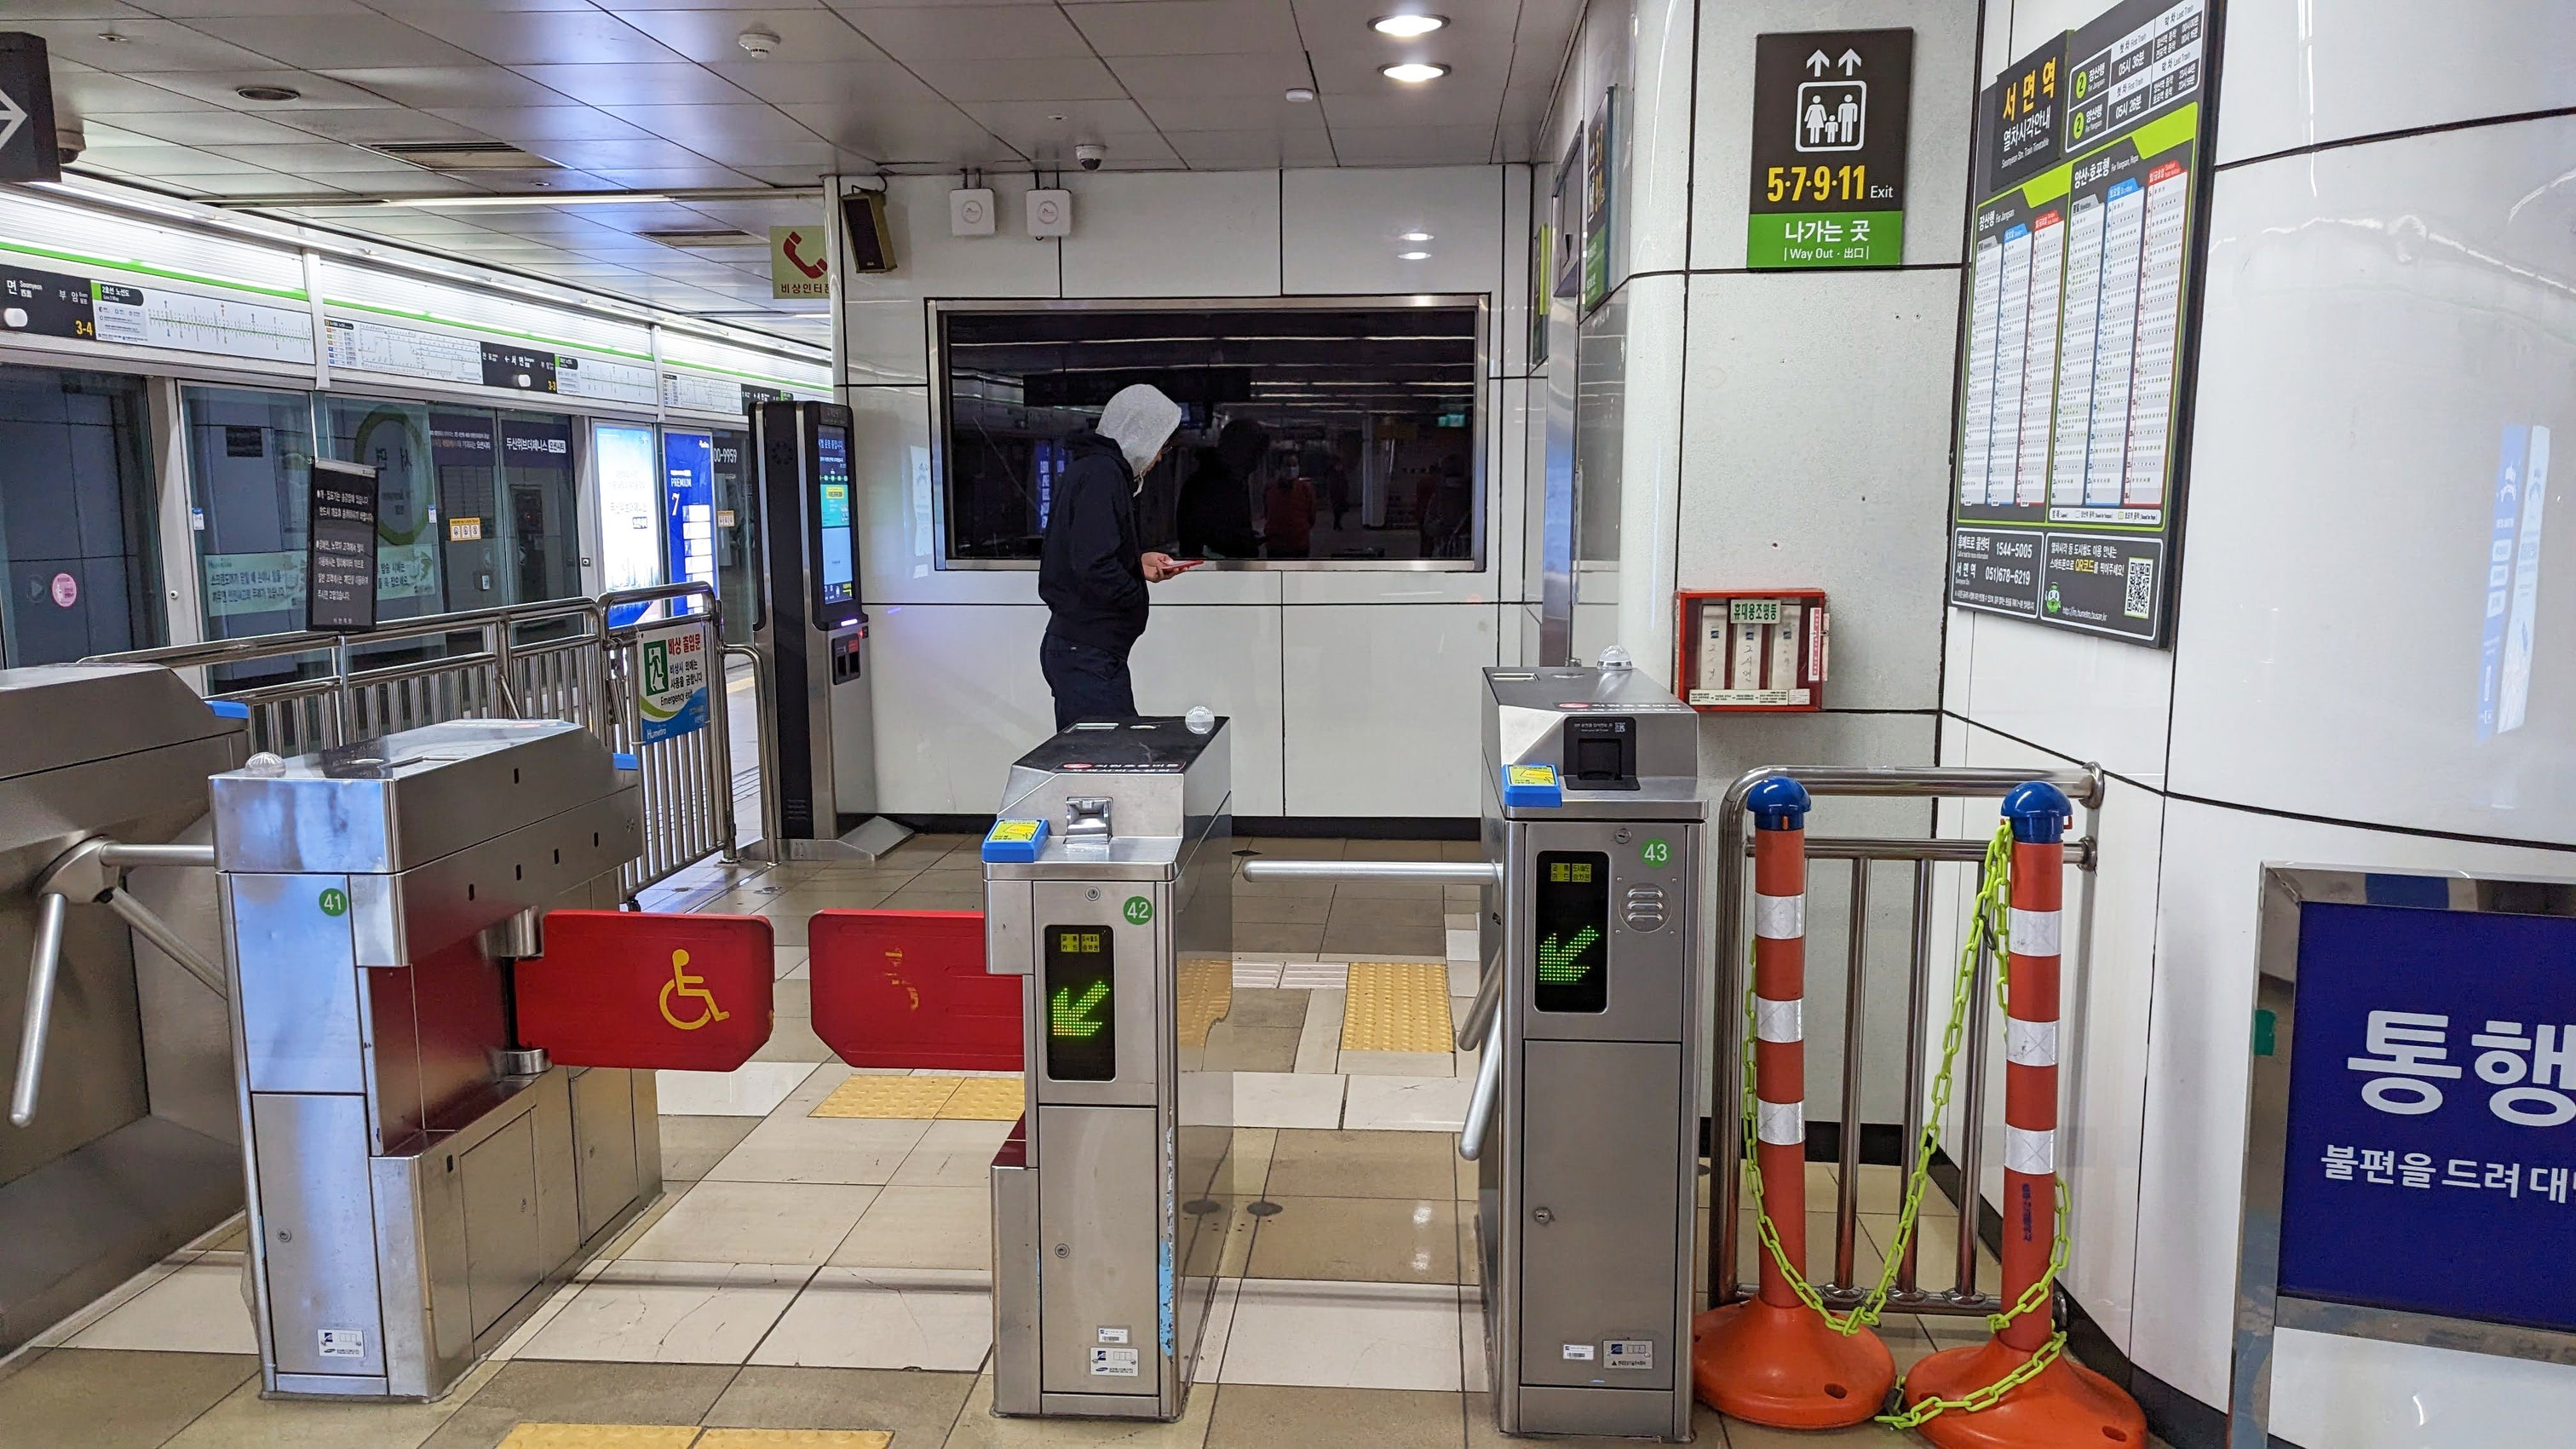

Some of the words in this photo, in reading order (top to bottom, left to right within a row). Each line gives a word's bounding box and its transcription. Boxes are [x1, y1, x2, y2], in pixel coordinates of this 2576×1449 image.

[2004, 105, 2051, 152] 열차시각안내
[1870, 184, 1894, 198] Exit
[1785, 221, 1843, 244] 나가는
[1850, 220, 1871, 243] 곳
[1790, 248, 1814, 261] Way
[1815, 248, 1833, 259] Out
[1843, 248, 1864, 259] 出口
[7, 279, 18, 296] 면
[75, 320, 94, 336] 3-4
[671, 478, 692, 487] PREMIUM
[672, 492, 680, 516] 7
[1996, 542, 2033, 559] 1544-5005
[1985, 566, 2030, 585] 051)678-6219
[1734, 603, 1777, 620] 휴대용조명등
[668, 636, 681, 655] 비상
[683, 633, 701, 653] 출입문
[660, 693, 685, 706] Emergency
[1643, 843, 1667, 861] 43
[324, 893, 341, 910] 41
[1126, 901, 1149, 920] 42
[2347, 1009, 2576, 1128] 통행
[2320, 1144, 2437, 1189] 불편을
[2441, 1159, 2519, 1199] 드려
[2529, 1166, 2576, 1204] 대
